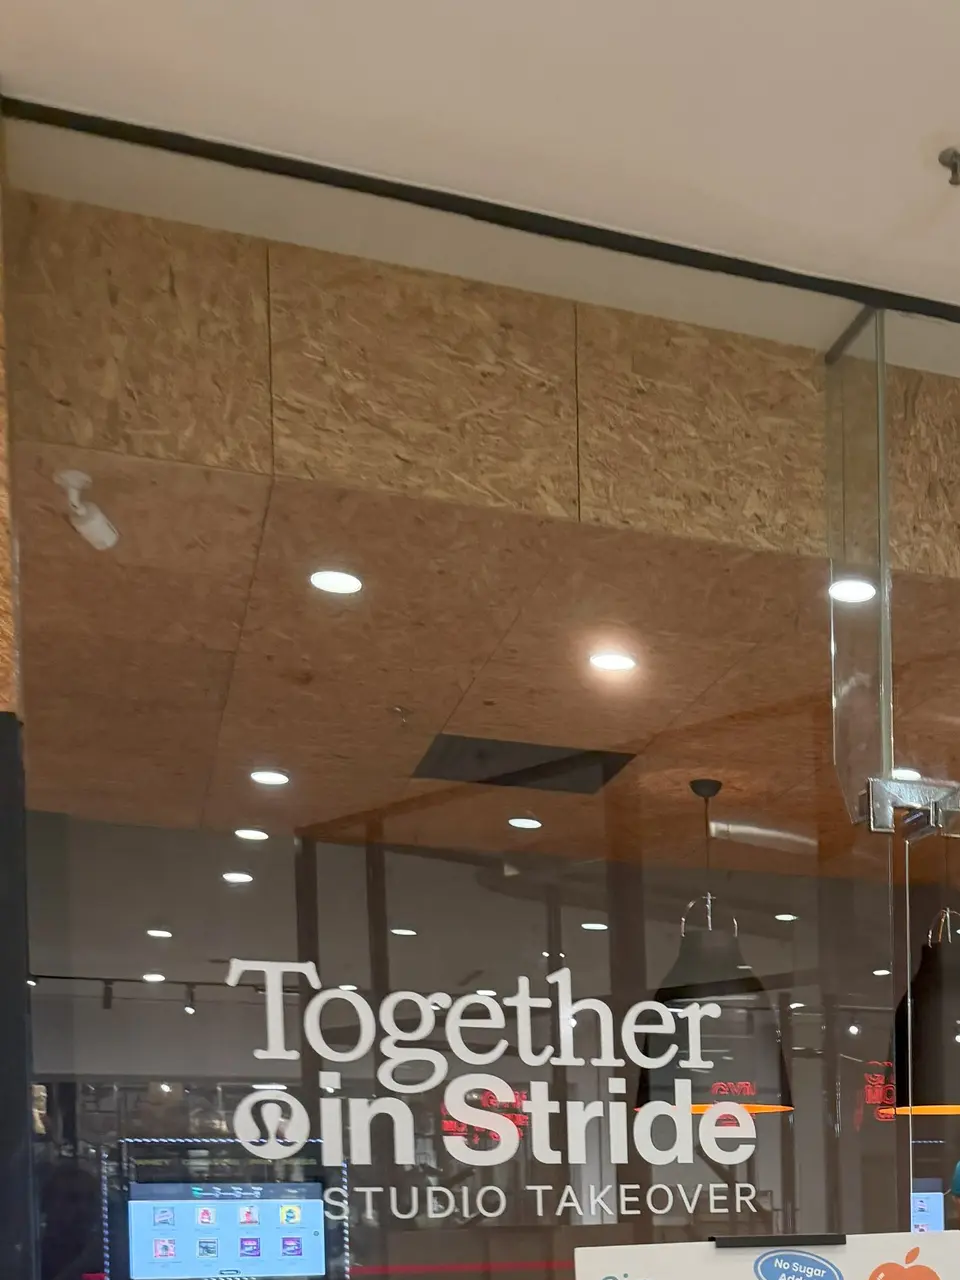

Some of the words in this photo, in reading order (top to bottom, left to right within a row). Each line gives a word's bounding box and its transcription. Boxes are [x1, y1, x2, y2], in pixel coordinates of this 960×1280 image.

[224, 958, 722, 1093] Together
[319, 1070, 416, 1167] in
[442, 1073, 757, 1166] Stride
[323, 1184, 507, 1221] STUDIO
[526, 1183, 758, 1216] TAKEOVER
[773, 1257, 790, 1270] No
[791, 1260, 827, 1280] Sugar
